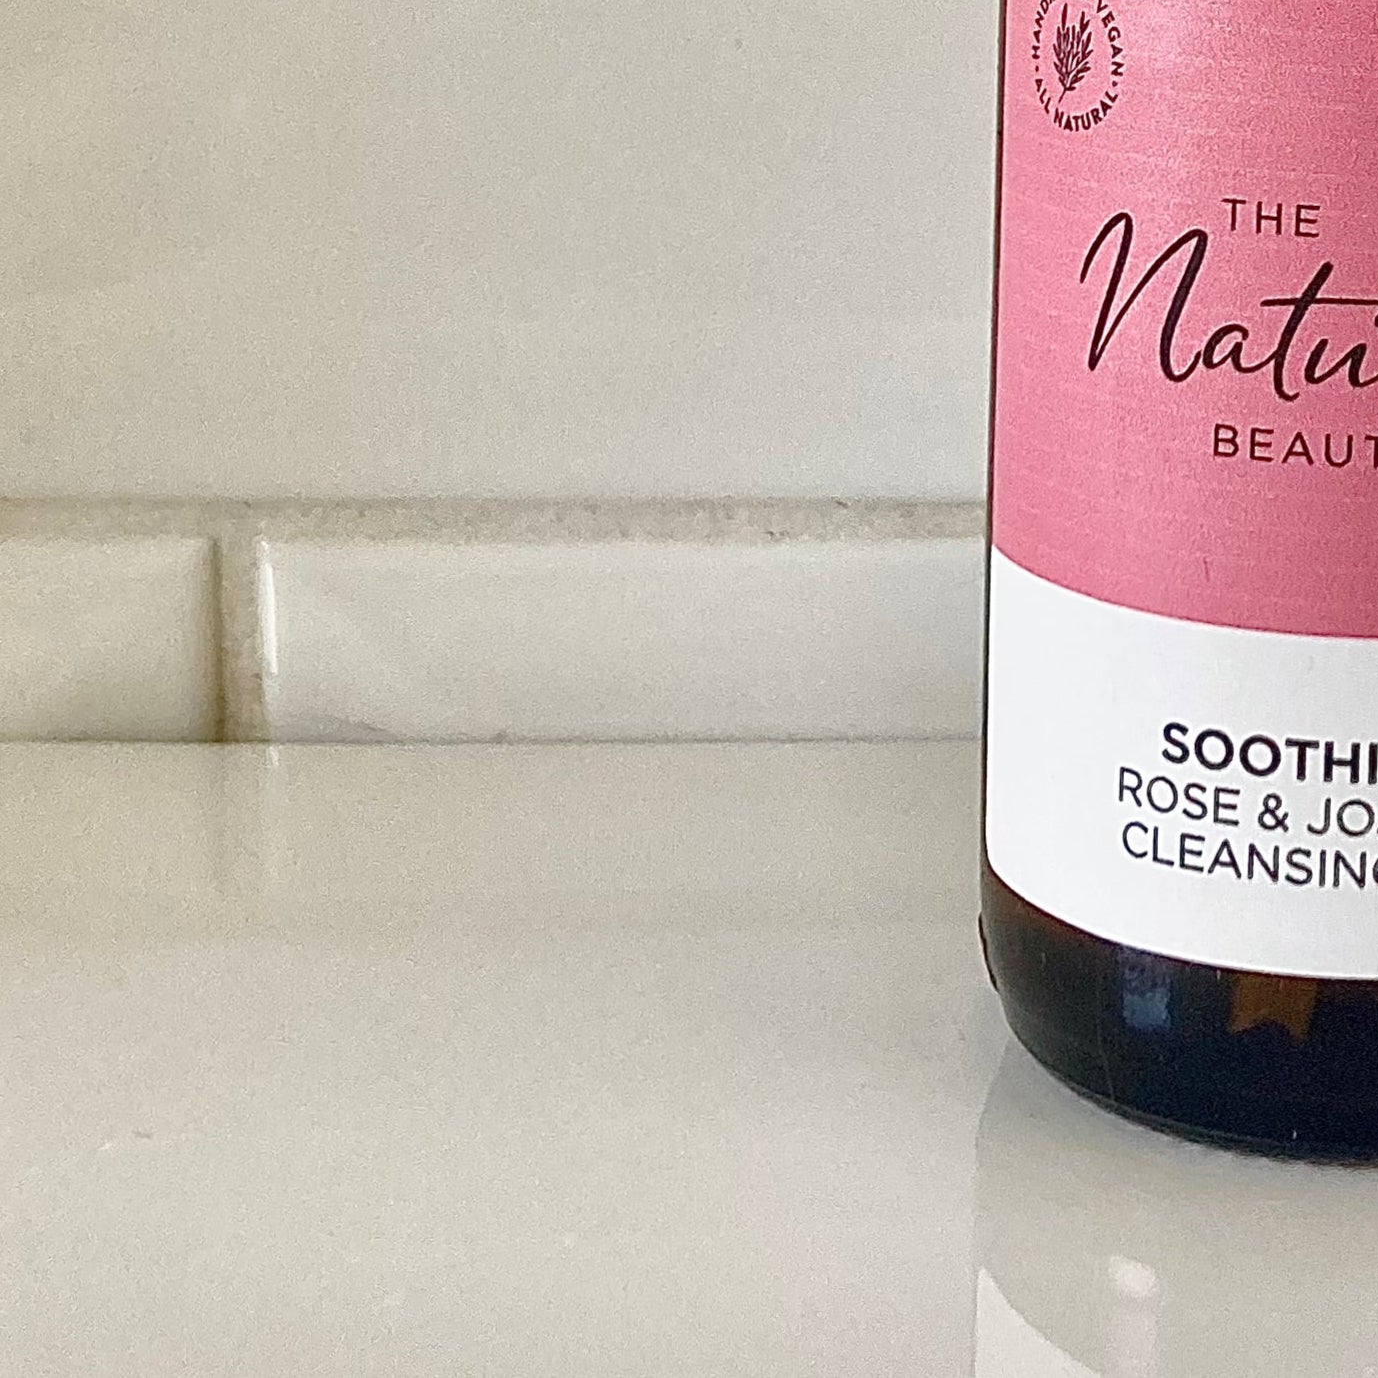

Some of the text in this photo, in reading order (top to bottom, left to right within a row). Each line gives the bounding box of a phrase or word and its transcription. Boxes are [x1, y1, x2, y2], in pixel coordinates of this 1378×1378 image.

[1034, 78, 1118, 132] ALL NATURAL
[1221, 198, 1321, 238] THE
[1118, 767, 1241, 827] ROSE
[1257, 793, 1290, 833] &
